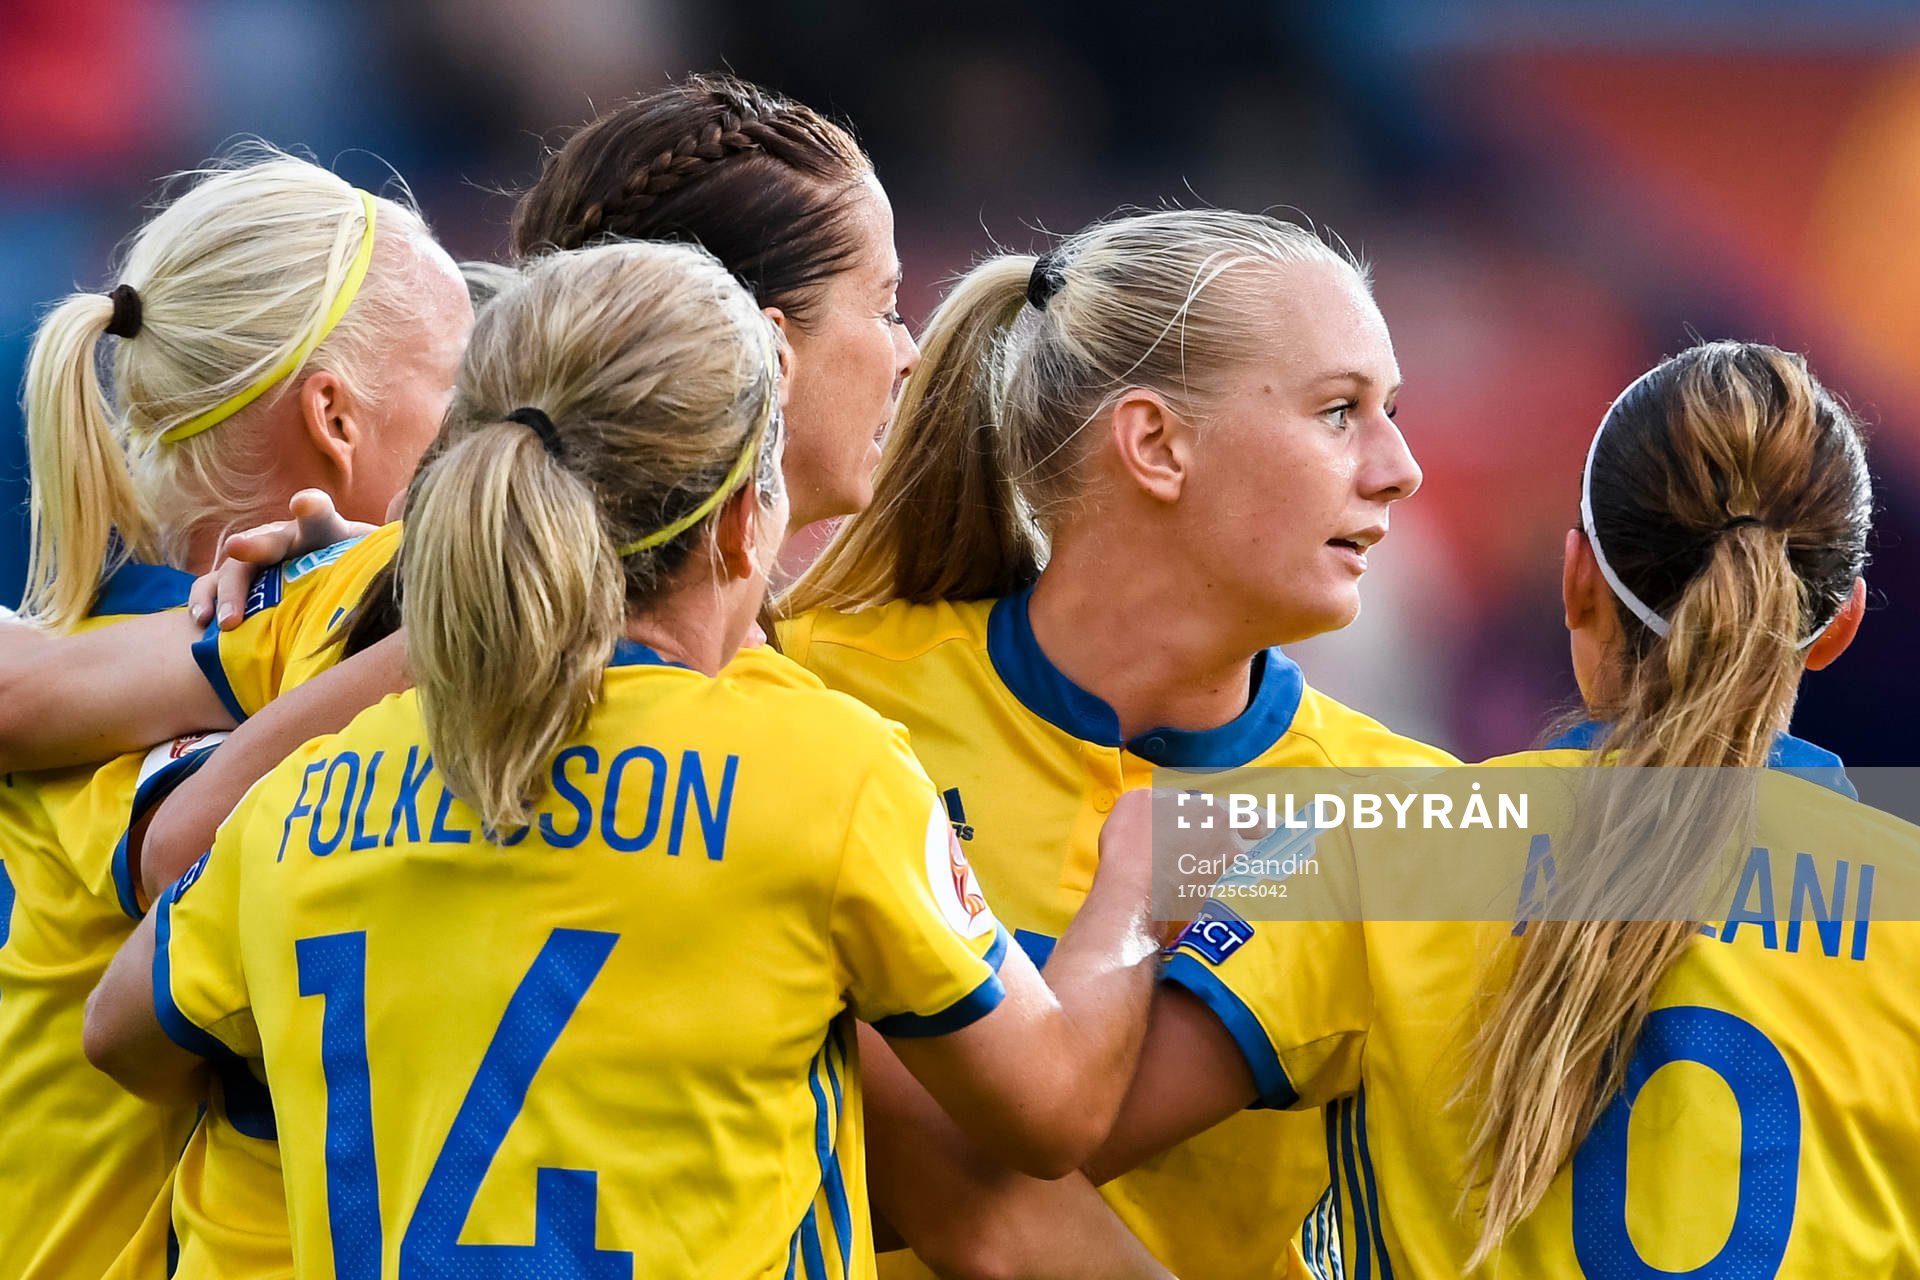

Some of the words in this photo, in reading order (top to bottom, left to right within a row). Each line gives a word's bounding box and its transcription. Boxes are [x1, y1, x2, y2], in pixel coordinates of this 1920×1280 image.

[277, 745, 739, 862] FOLKSON
[1511, 834, 1875, 961] AANI
[295, 927, 634, 1280] 14
